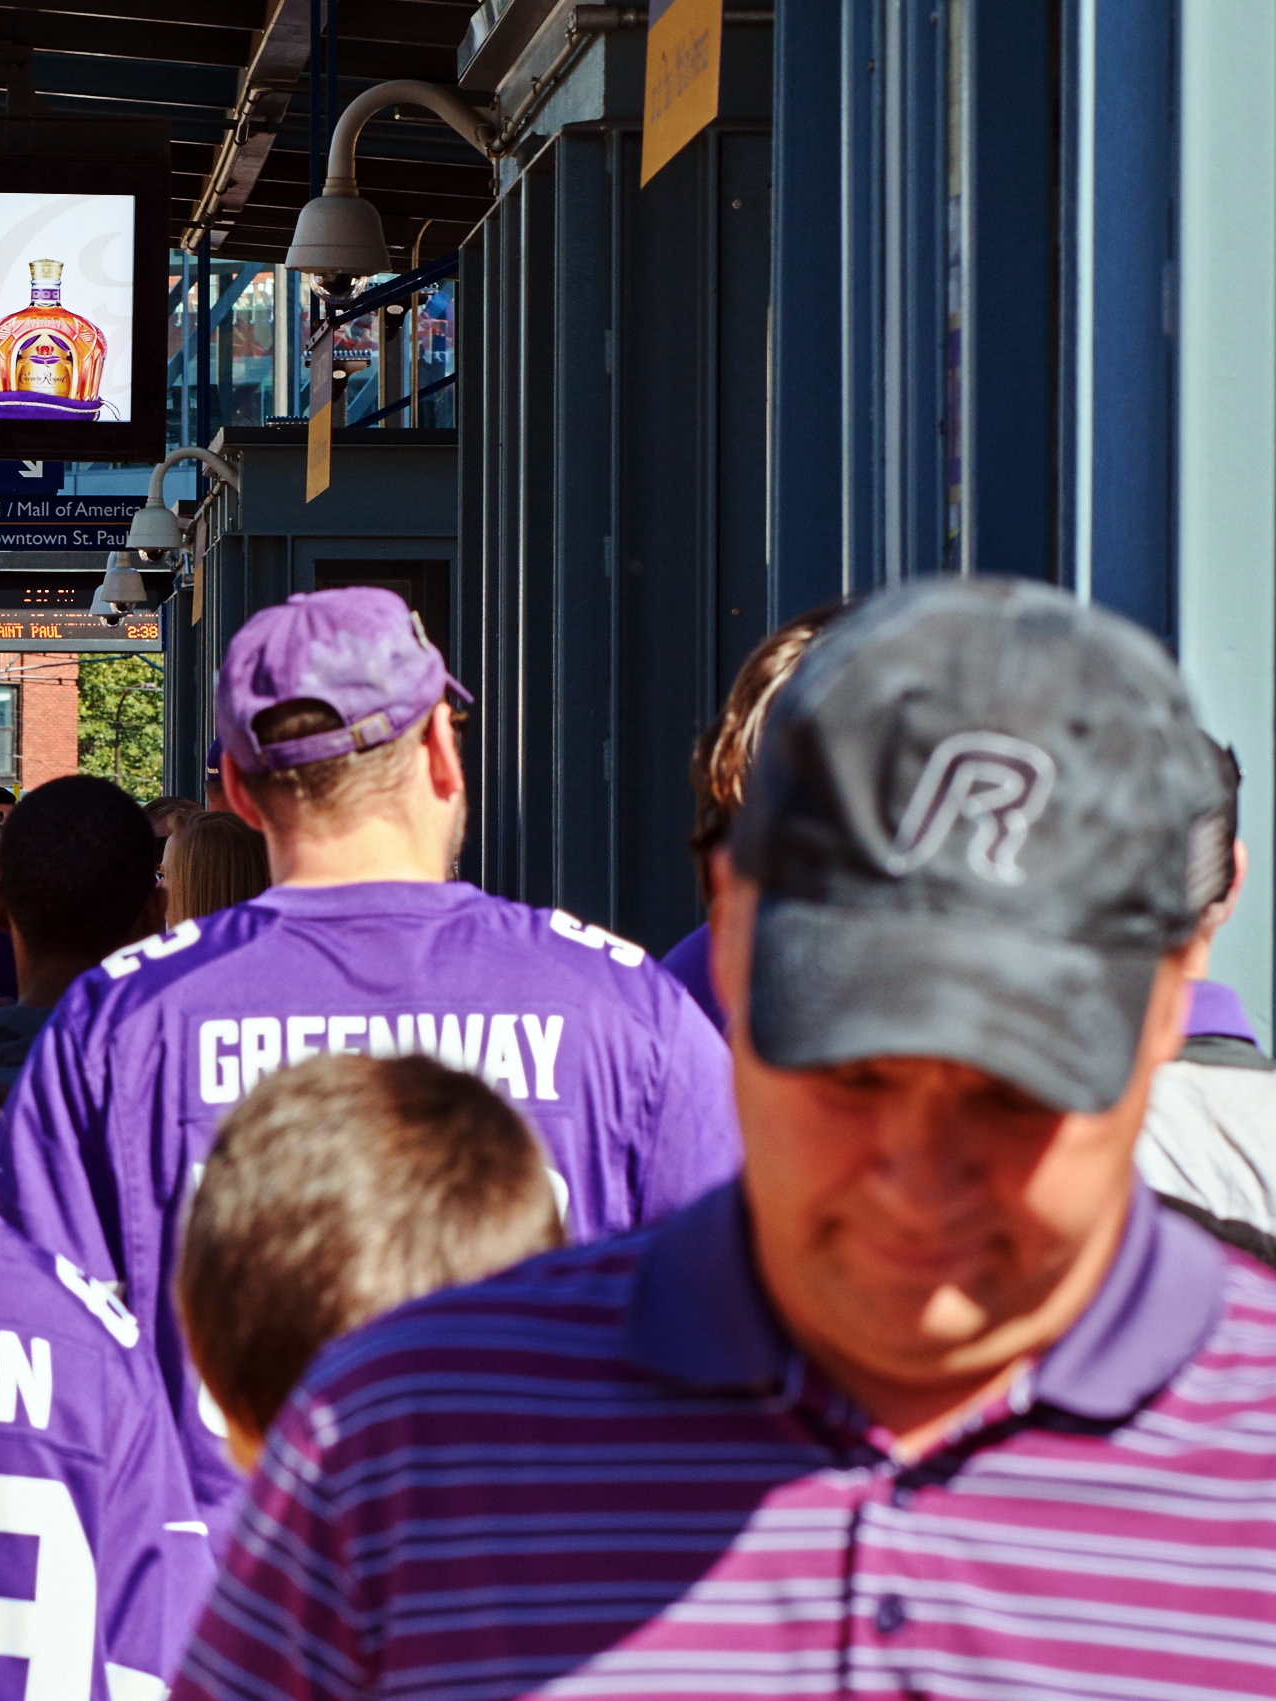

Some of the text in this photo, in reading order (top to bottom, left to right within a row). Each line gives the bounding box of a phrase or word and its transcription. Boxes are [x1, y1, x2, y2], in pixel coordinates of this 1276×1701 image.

[17, 501, 50, 517] Mall
[55, 501, 73, 517] of
[73, 530, 93, 545] St.
[31, 625, 63, 639] PAUL
[127, 625, 159, 639] 2:38
